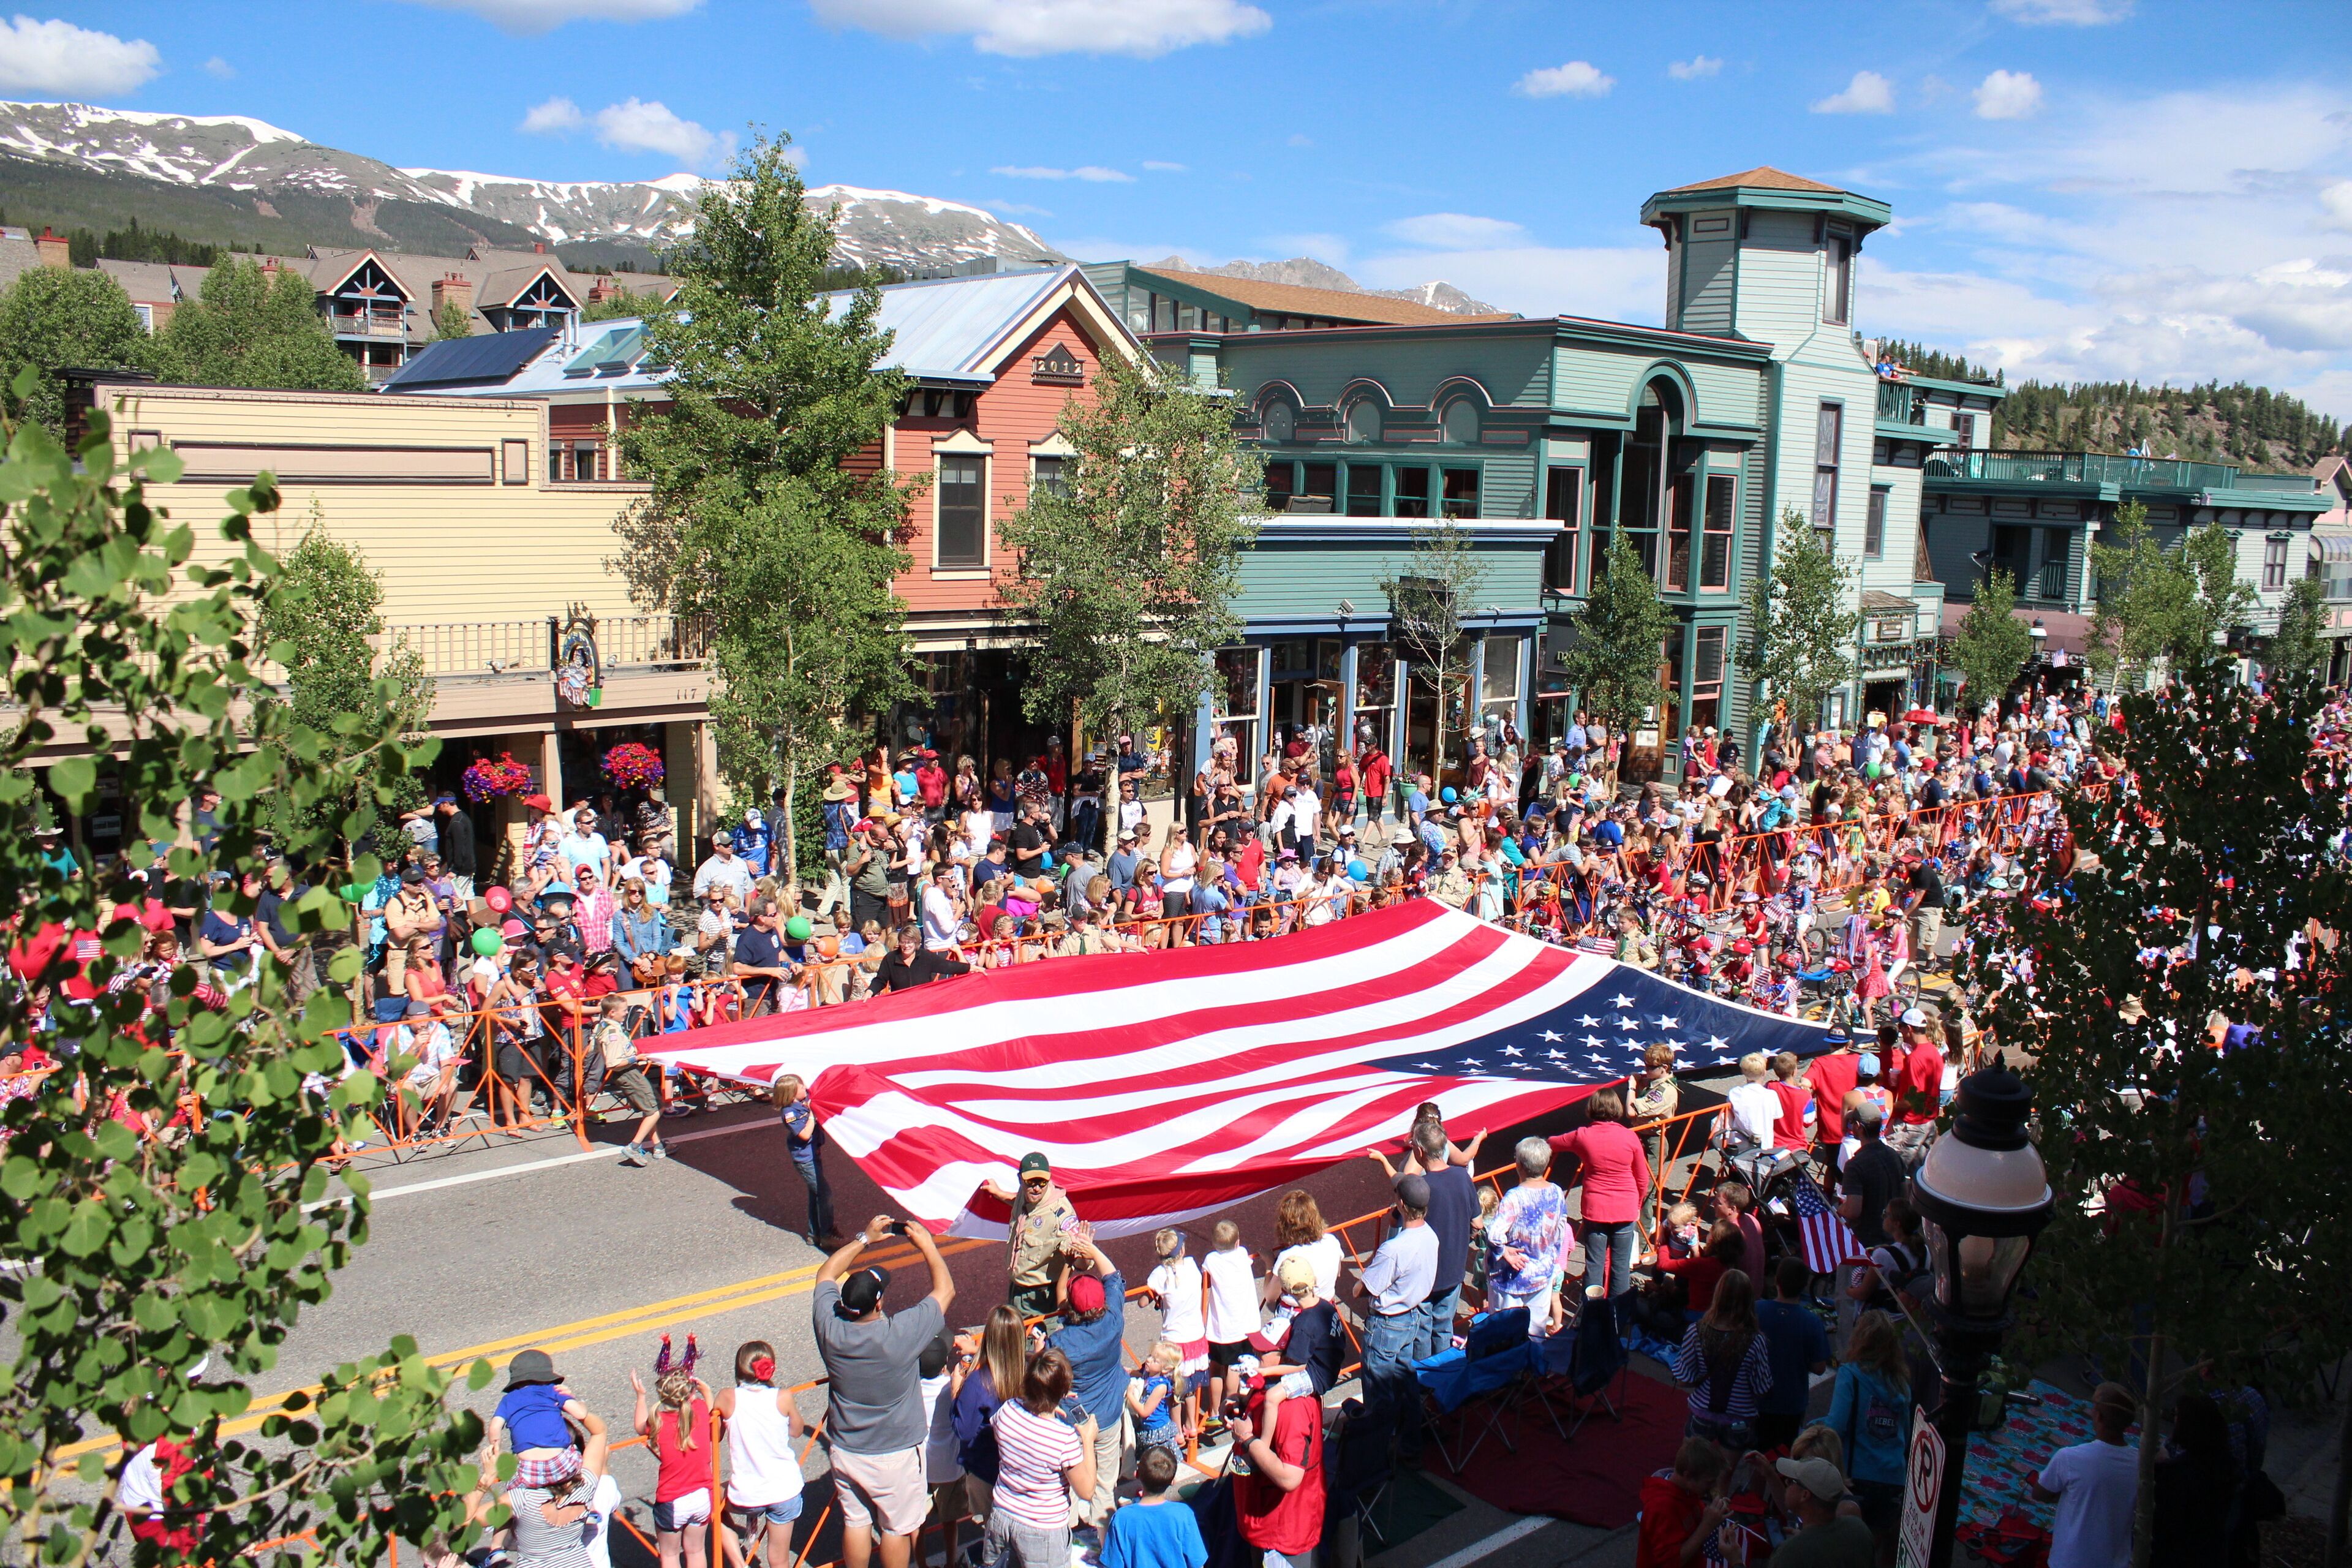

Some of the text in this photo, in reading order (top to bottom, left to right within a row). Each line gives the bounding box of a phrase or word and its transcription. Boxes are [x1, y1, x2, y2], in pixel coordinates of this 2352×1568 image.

[1038, 360, 1081, 374] 2012
[677, 687, 697, 701] 117
[1875, 1416, 1894, 1426] REBEL
[1918, 1521, 1924, 1539] AM
[1920, 1541, 1926, 1561] AM
